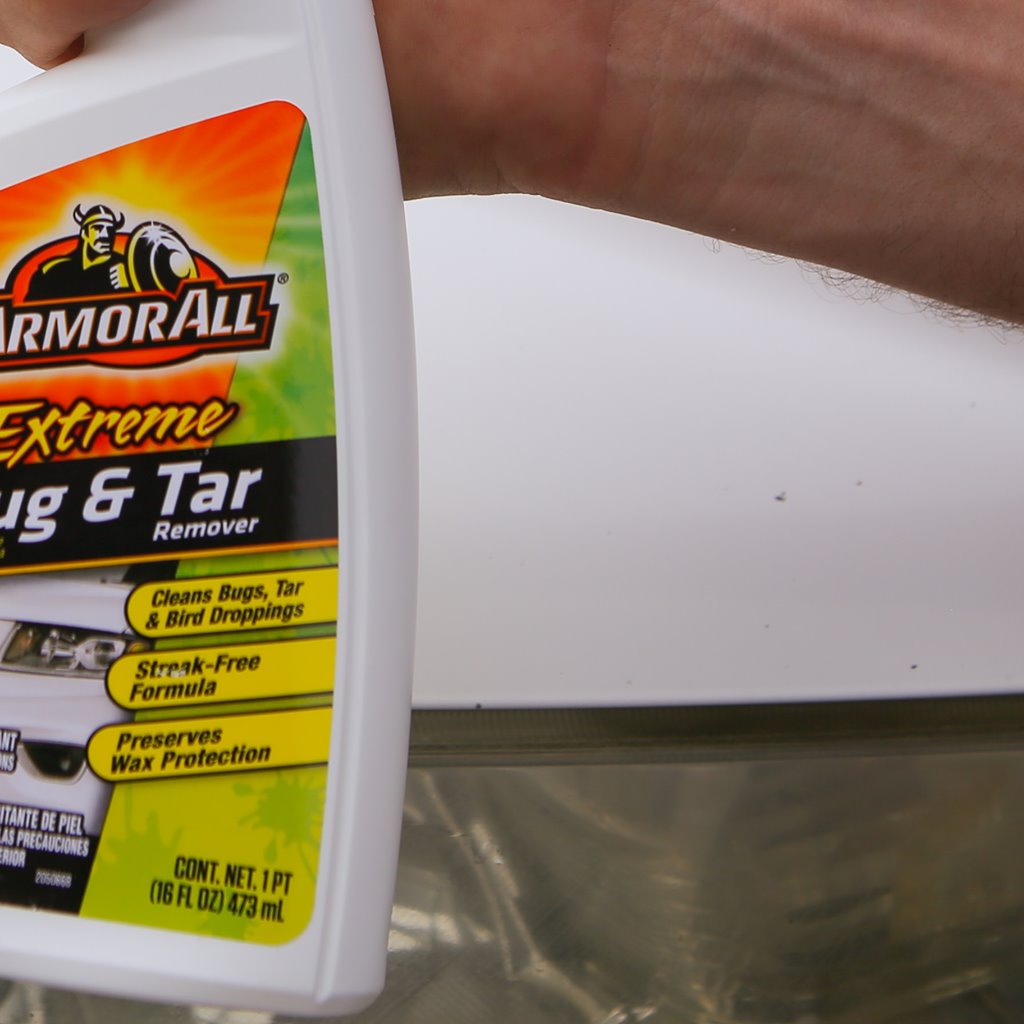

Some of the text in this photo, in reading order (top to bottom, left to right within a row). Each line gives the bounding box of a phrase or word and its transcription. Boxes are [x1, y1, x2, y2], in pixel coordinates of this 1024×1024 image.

[82, 467, 135, 523] &
[157, 460, 263, 516] Tar
[152, 517, 259, 542] Remover
[151, 579, 304, 608] Cleans Bugs, Tar
[145, 602, 304, 630] & Bird Droppings
[135, 655, 261, 680] Streak-Free
[129, 678, 217, 703] Formula
[116, 728, 222, 752] Preserves
[111, 745, 272, 775] Wax Protection
[41, 810, 57, 832] DE
[16, 831, 89, 857] PRECAUCIONES
[174, 856, 293, 896] CONT. NET. 1 PT
[150, 879, 284, 923] (16 FL OZ) 473 mL
